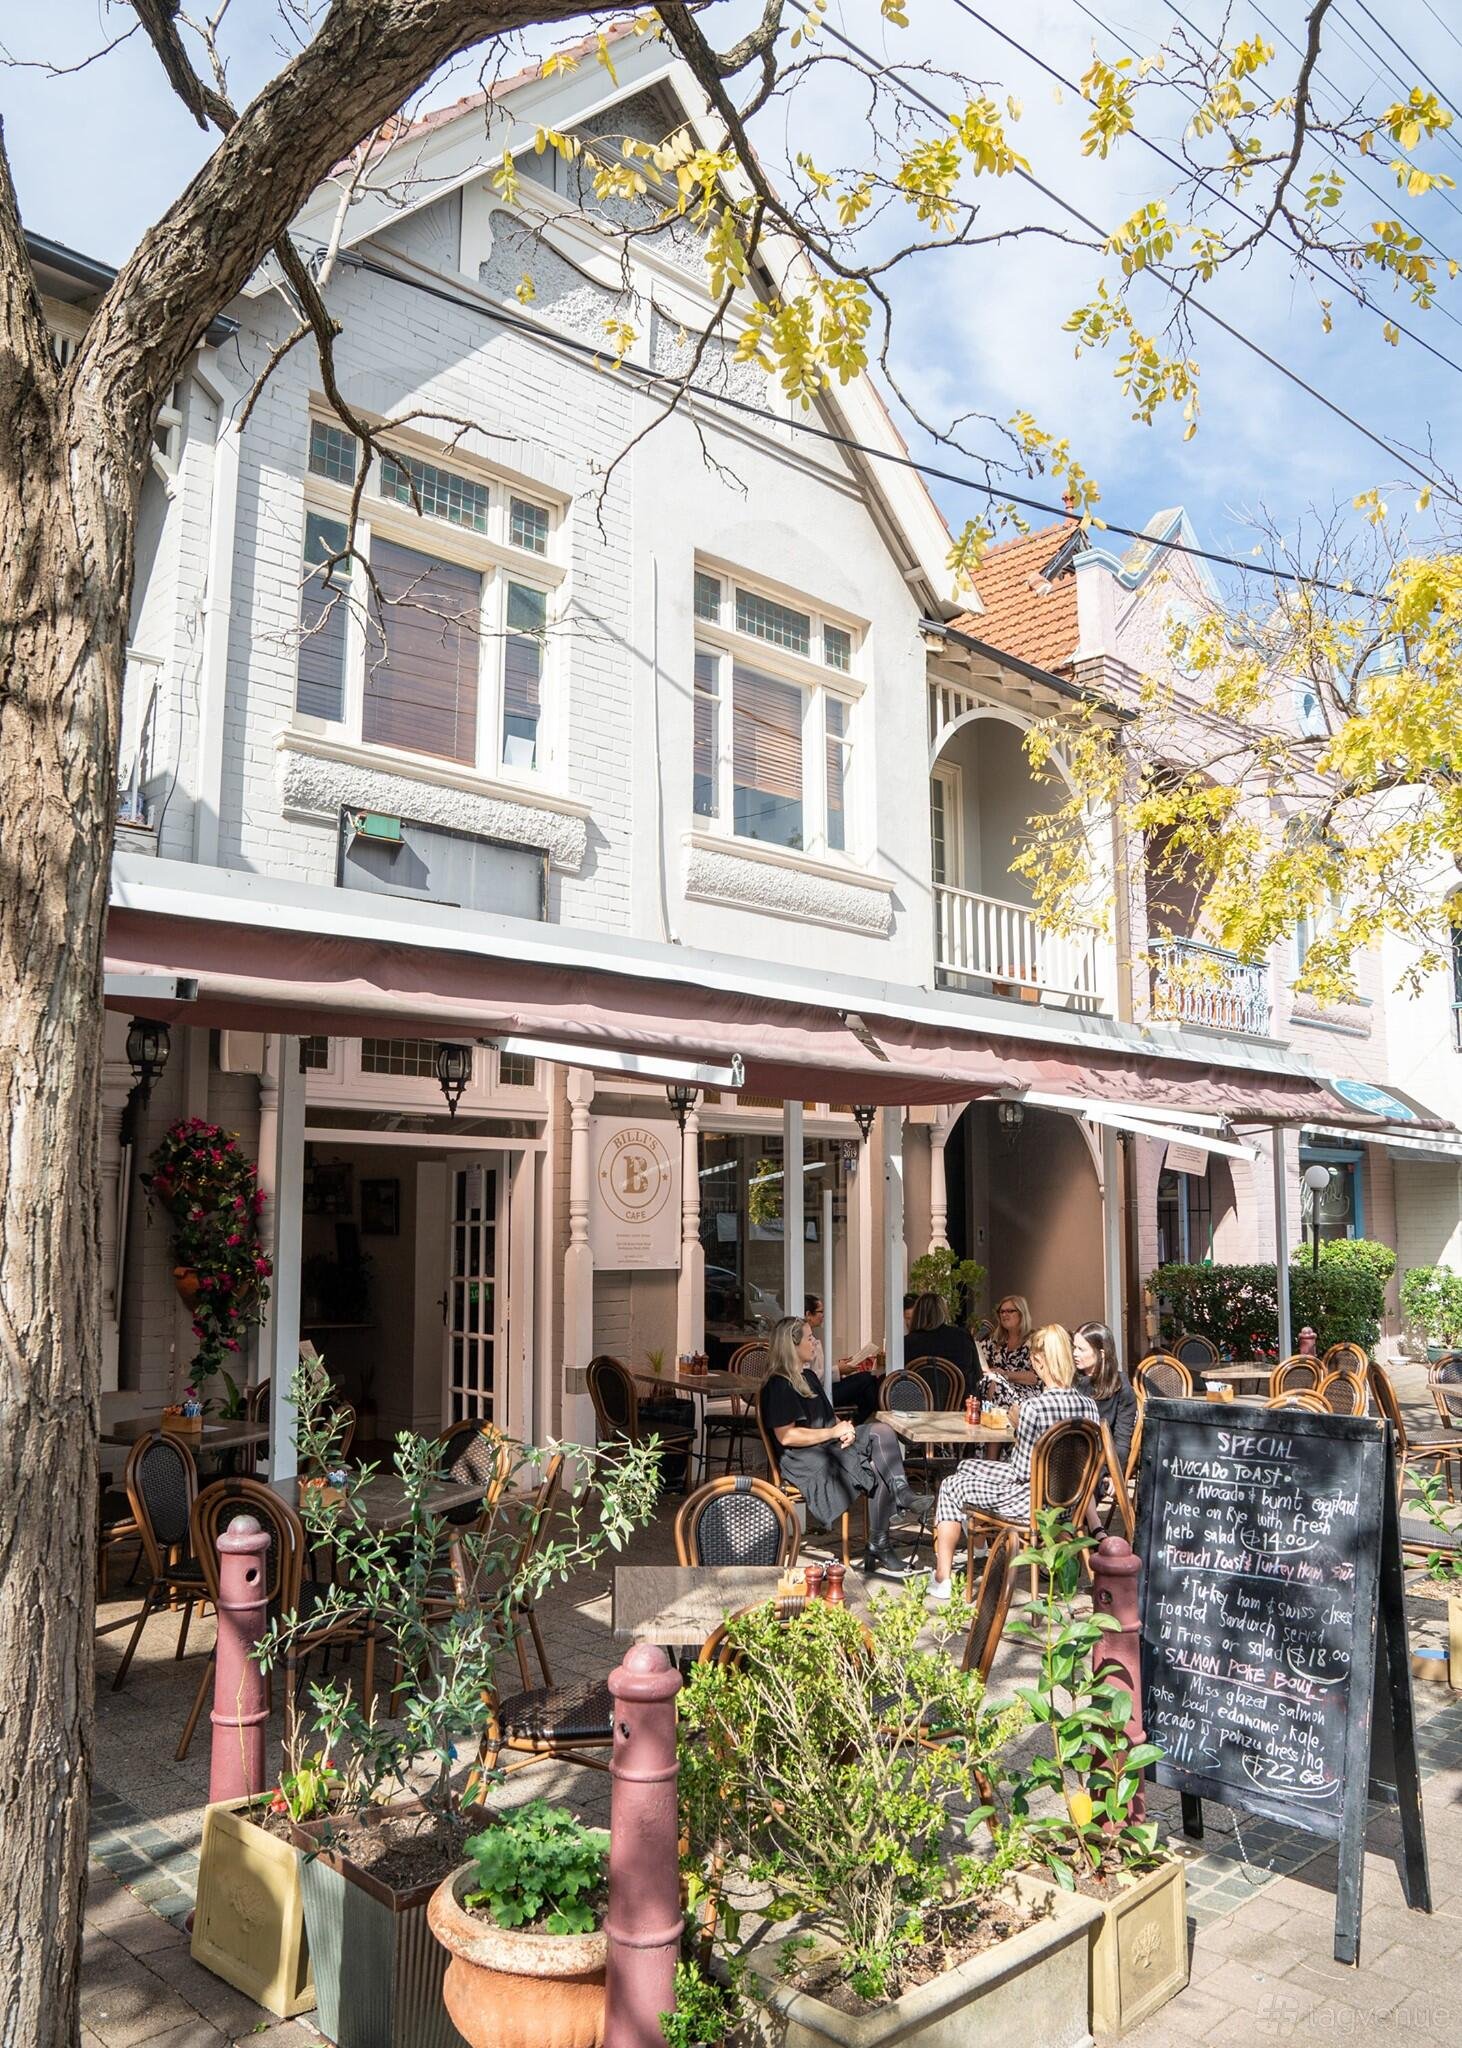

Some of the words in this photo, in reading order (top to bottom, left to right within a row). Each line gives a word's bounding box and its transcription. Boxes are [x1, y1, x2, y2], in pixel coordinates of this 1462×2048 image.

[613, 1131, 658, 1150] BILLI'S
[1217, 1432, 1300, 1459] SPECIAL
[1197, 1480, 1245, 1501] Avocado
[1163, 1500, 1200, 1521] puree
[1206, 1506, 1222, 1519] on
[1226, 1506, 1248, 1529] Rye
[1257, 1511, 1283, 1531] with
[1293, 1513, 1331, 1535] fresh
[1165, 1522, 1195, 1541] herb
[1204, 1525, 1236, 1545] salad
[1165, 1544, 1212, 1568] French
[1213, 1549, 1247, 1572] Toast
[1255, 1552, 1295, 1587] Turkey
[1156, 1595, 1208, 1624] toasted
[1191, 1579, 1229, 1612] Turkey
[1237, 1588, 1261, 1610] ham
[1176, 1626, 1212, 1648] Fries
[1222, 1638, 1240, 1652] or
[1248, 1638, 1284, 1663] salad
[1165, 1647, 1221, 1676] SALMON
[1189, 1675, 1220, 1698] Miso
[1226, 1686, 1268, 1710] glazed
[1219, 1727, 1262, 1749] ponzu
[1265, 1736, 1324, 1776] dressing
